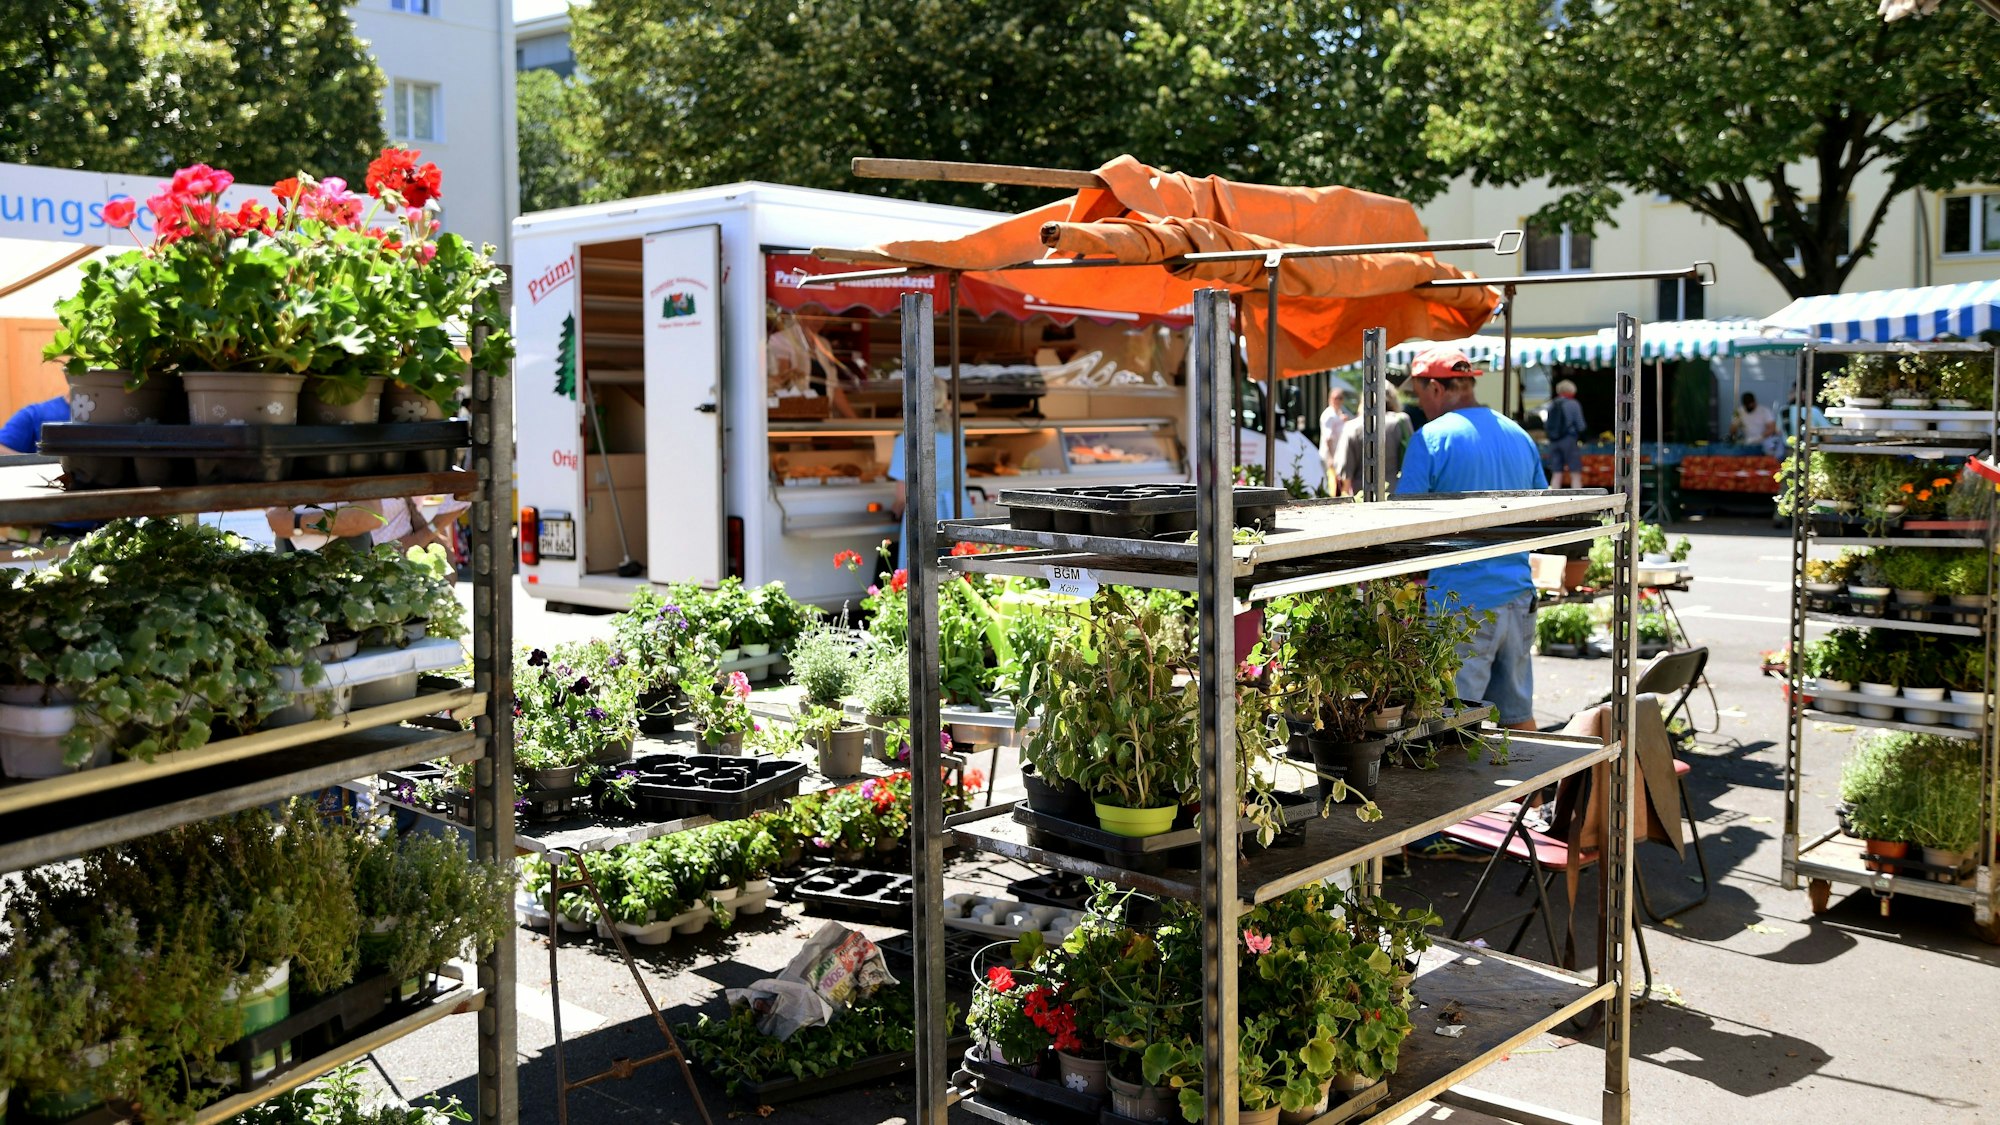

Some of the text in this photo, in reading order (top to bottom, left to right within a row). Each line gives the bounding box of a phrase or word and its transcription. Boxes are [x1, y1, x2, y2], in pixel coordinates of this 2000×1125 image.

[543, 522, 560, 537] BIT
[555, 539, 570, 552] 662
[1053, 567, 1080, 580] BGM
[1059, 583, 1079, 594] Köln
